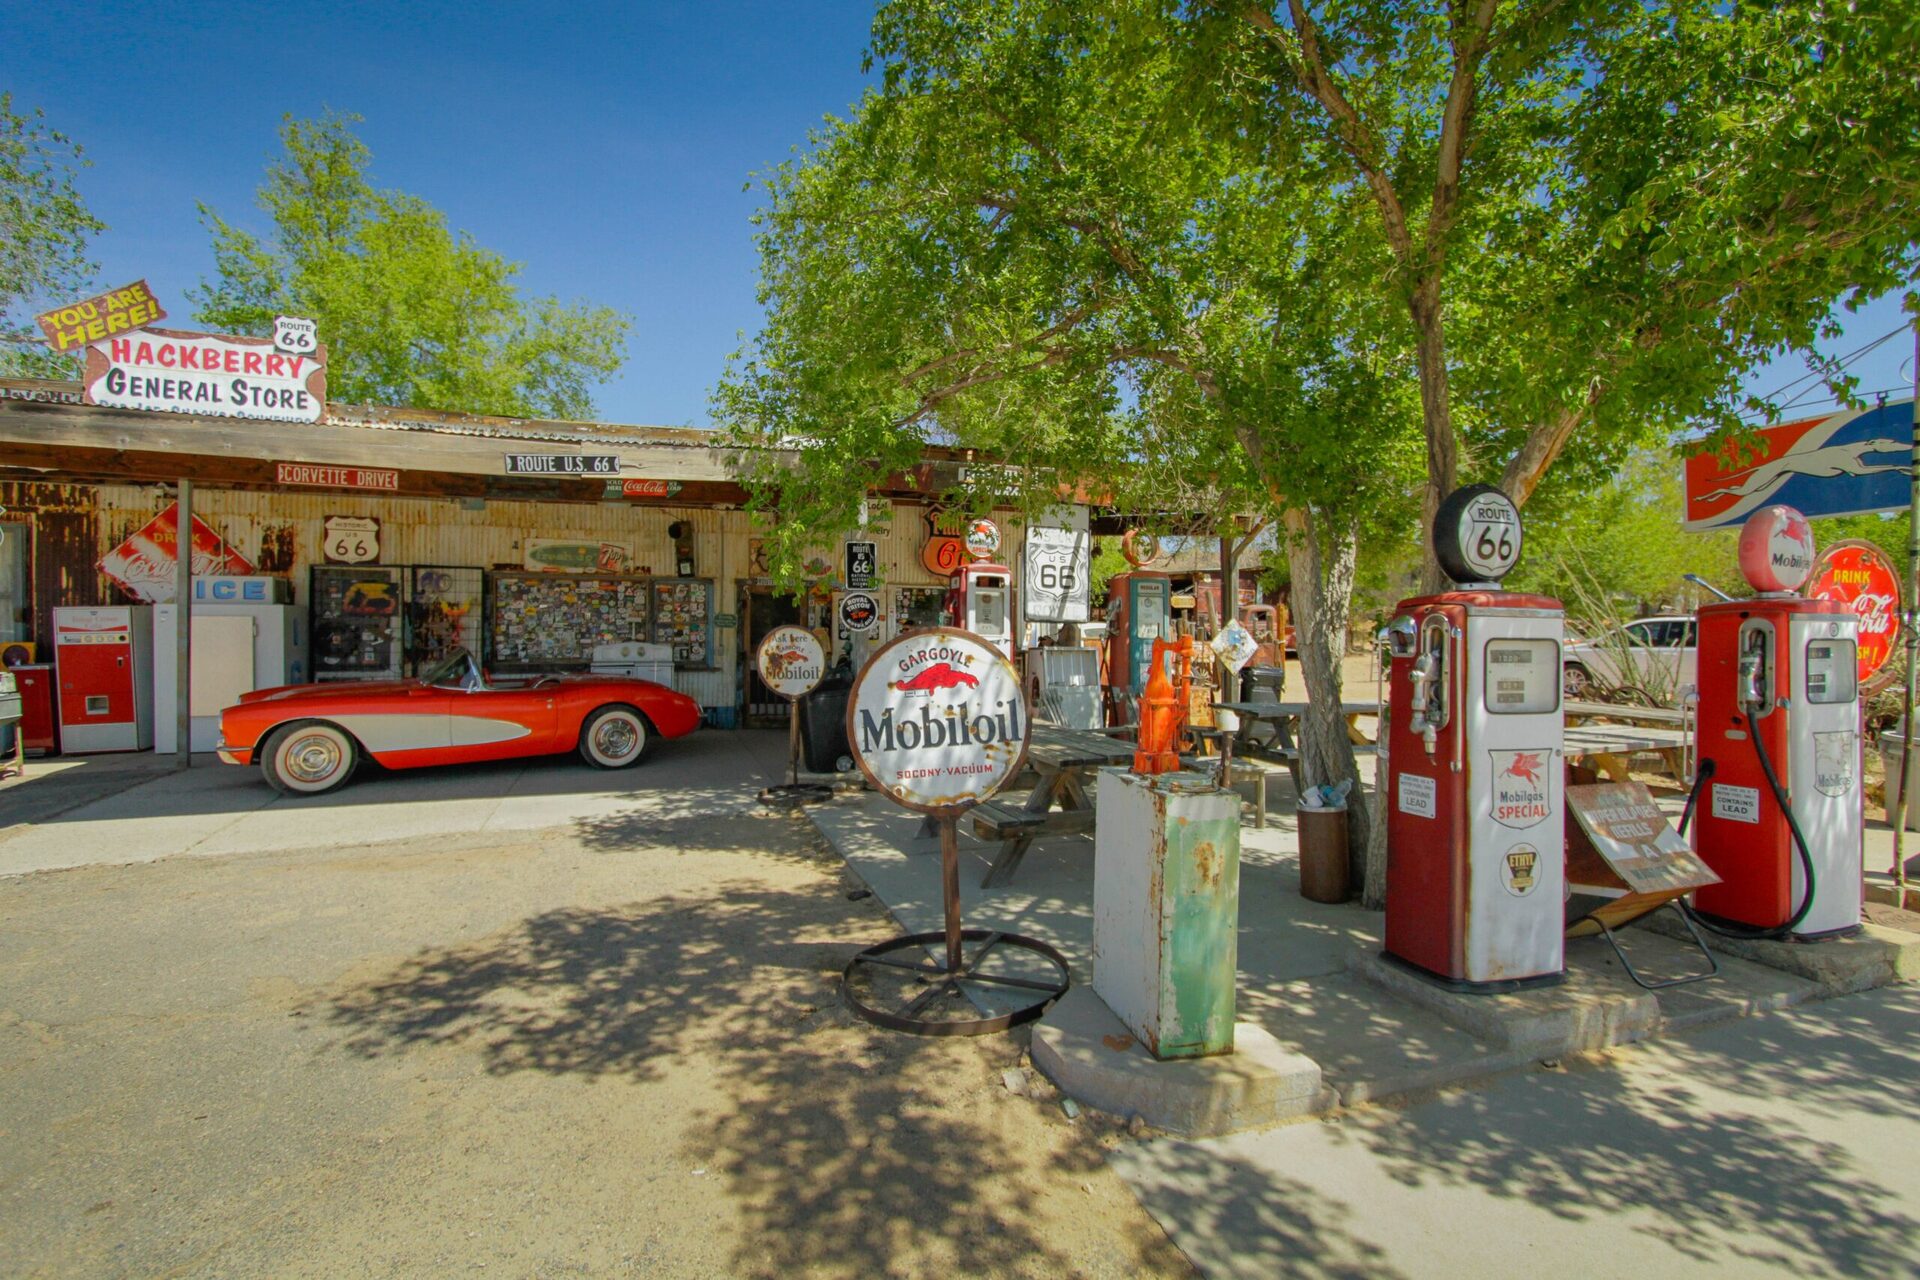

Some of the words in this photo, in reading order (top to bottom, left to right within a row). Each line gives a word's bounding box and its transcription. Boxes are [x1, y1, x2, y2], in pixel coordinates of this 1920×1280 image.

[45, 302, 97, 330] YOU
[105, 284, 148, 313] ARE
[56, 301, 158, 350] HERE!
[279, 322, 312, 332] ROUTE
[281, 332, 311, 348] 66
[111, 338, 304, 379] HACKBERRY
[106, 367, 222, 403] GENERAL
[231, 378, 309, 410] STORE
[517, 456, 555, 472] ROUTE
[564, 457, 587, 472] U.S.
[594, 457, 609, 471] 66
[284, 467, 348, 485] CORVETTE
[357, 471, 393, 488] DRIVE
[1477, 508, 1512, 521] ROUTE
[153, 532, 201, 543] DRK
[1477, 525, 1512, 561] 66
[335, 539, 368, 557] 66
[852, 560, 871, 573] 66
[1040, 564, 1075, 589] 66
[1833, 570, 1871, 583] DRINK
[196, 580, 266, 600] ICE
[846, 602, 871, 612] TRITON
[847, 597, 868, 606] ROYAL
[898, 647, 972, 672] GARGOYLE
[765, 666, 820, 680] Mobiloil
[860, 698, 1022, 753] Mobiloil
[1406, 796, 1427, 809] LEAD
[1500, 791, 1544, 804] Mobilgas
[1716, 796, 1754, 807] CONTAINS
[1498, 804, 1547, 819] SPECIAL
[1722, 804, 1748, 814] LEAD
[1509, 854, 1534, 867] ETHYL
